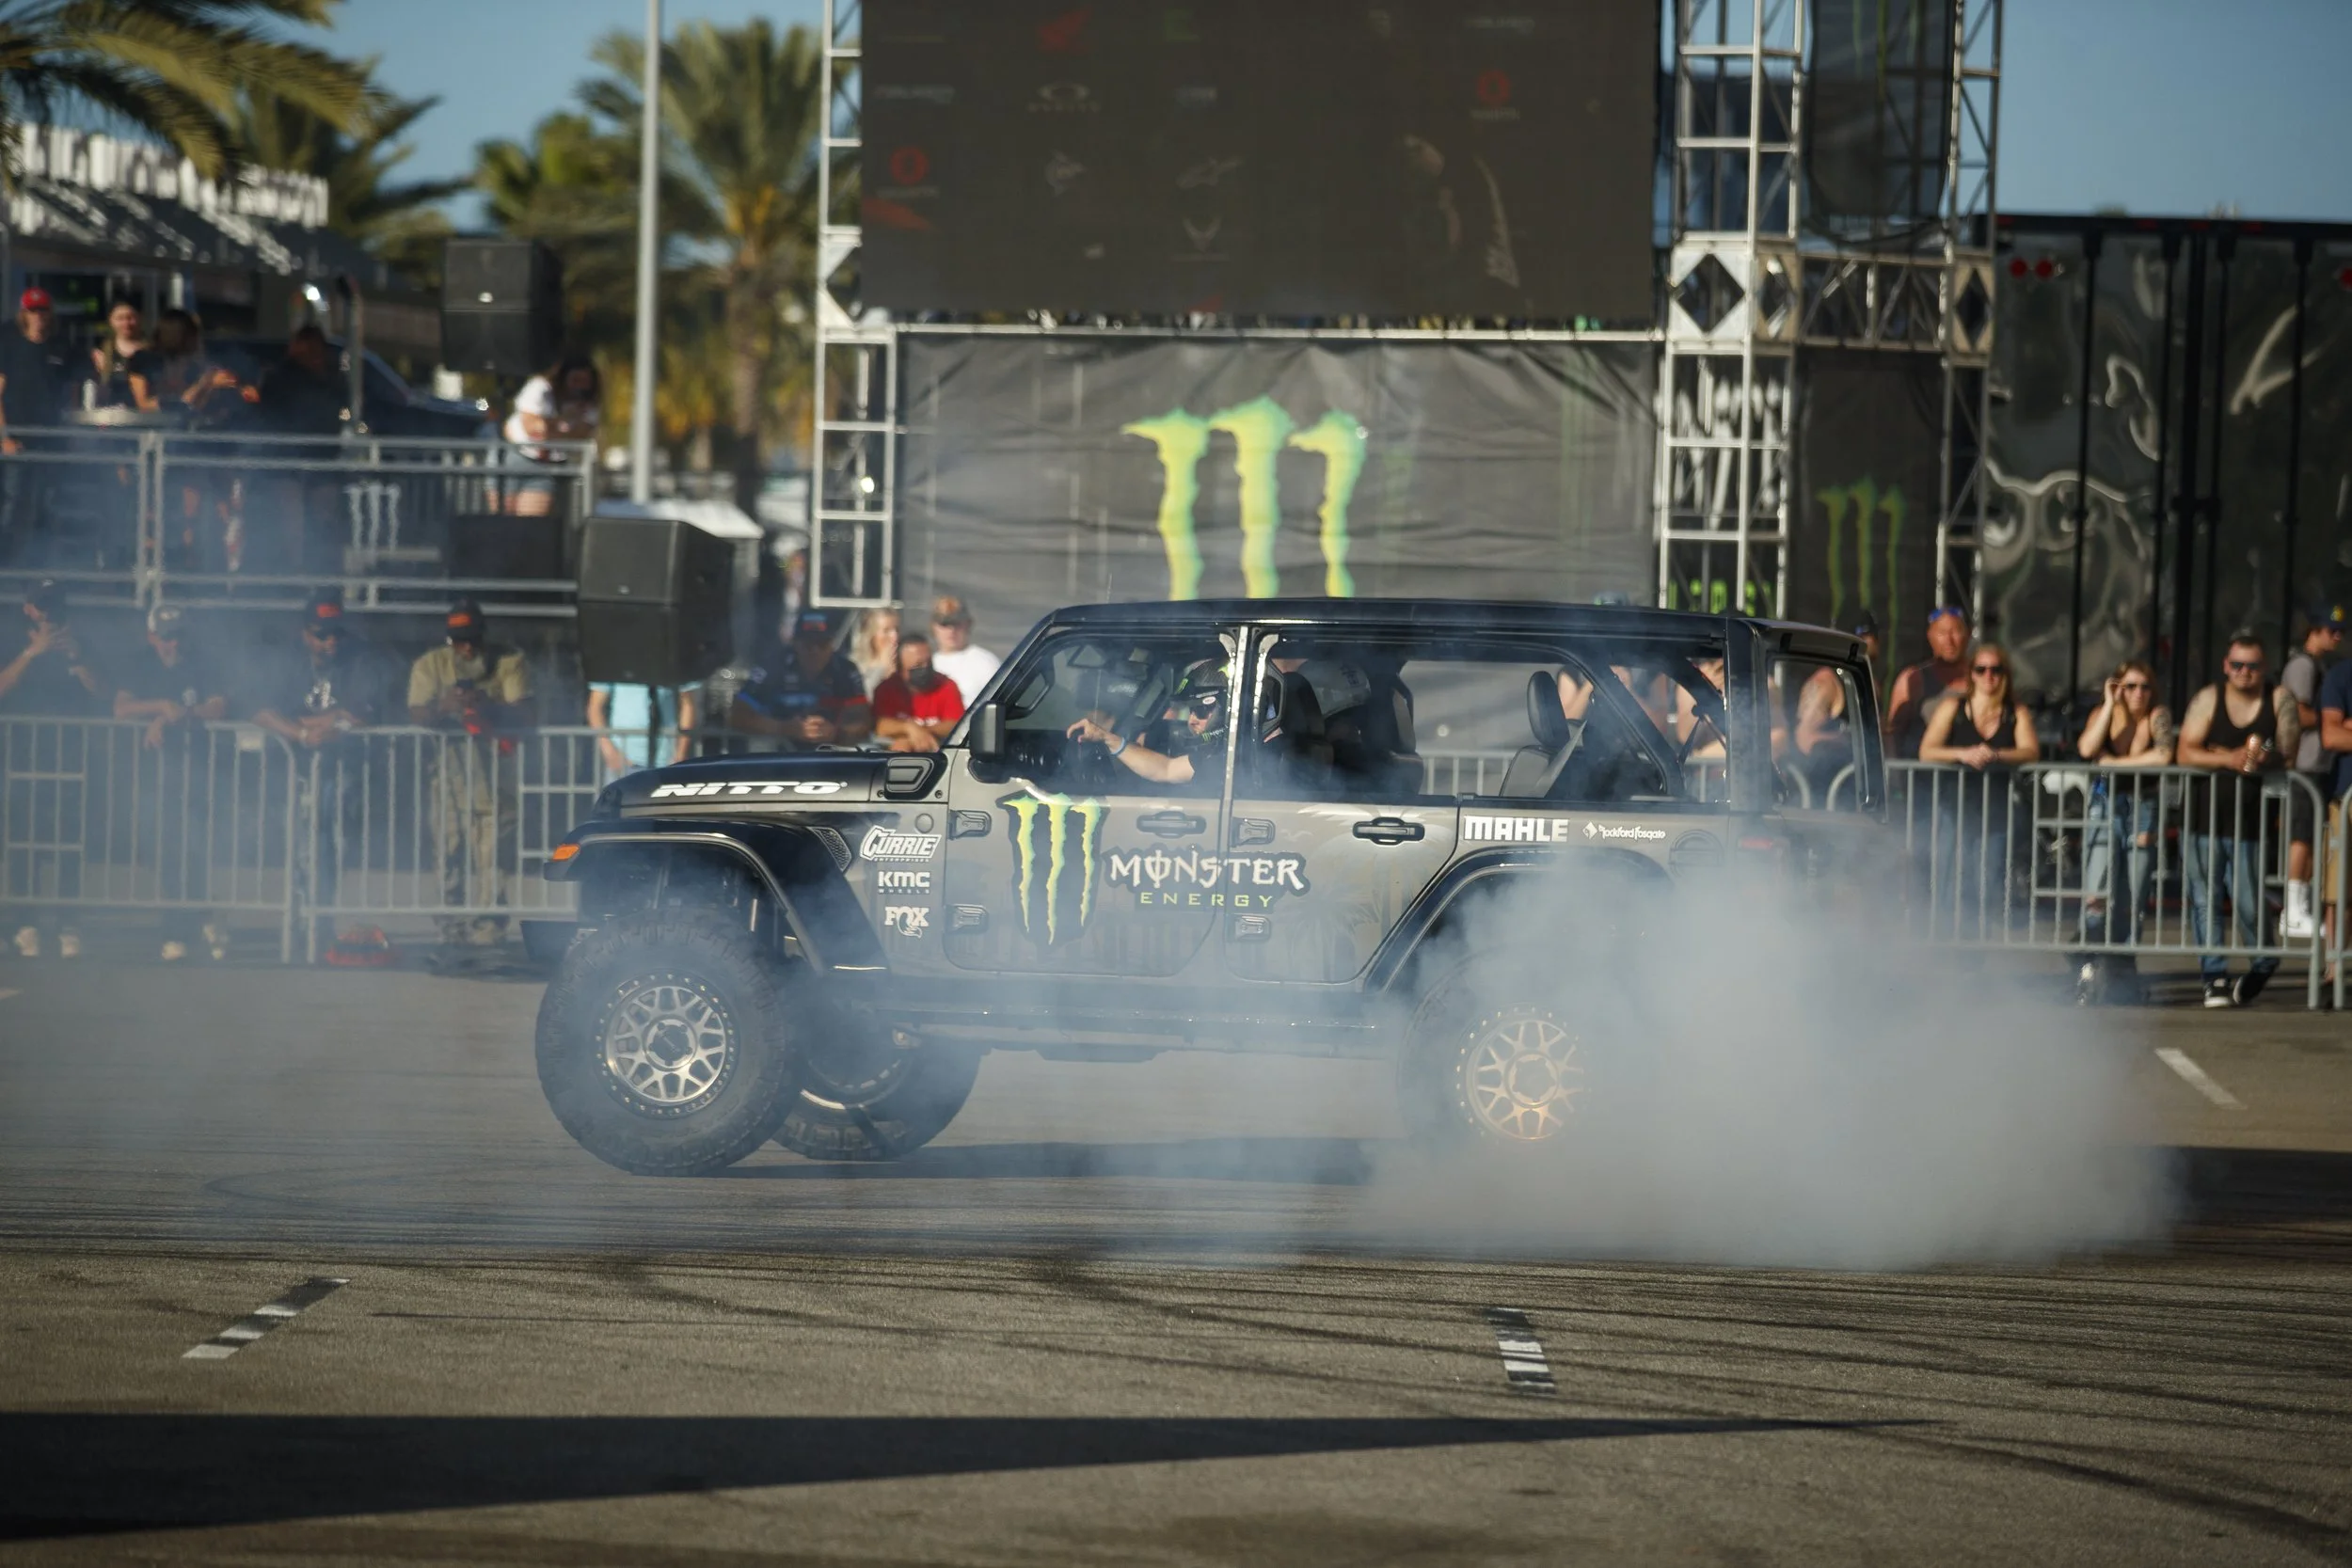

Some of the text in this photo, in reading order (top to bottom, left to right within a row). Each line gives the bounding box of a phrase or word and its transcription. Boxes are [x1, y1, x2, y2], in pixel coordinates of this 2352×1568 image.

[651, 782, 841, 798] NITTO
[1464, 816, 1568, 842] MAHLE
[862, 827, 938, 858] CURRIE
[1110, 849, 1304, 890] MONSTER
[1140, 893, 1273, 908] ENERGY
[884, 906, 930, 933] FOX
